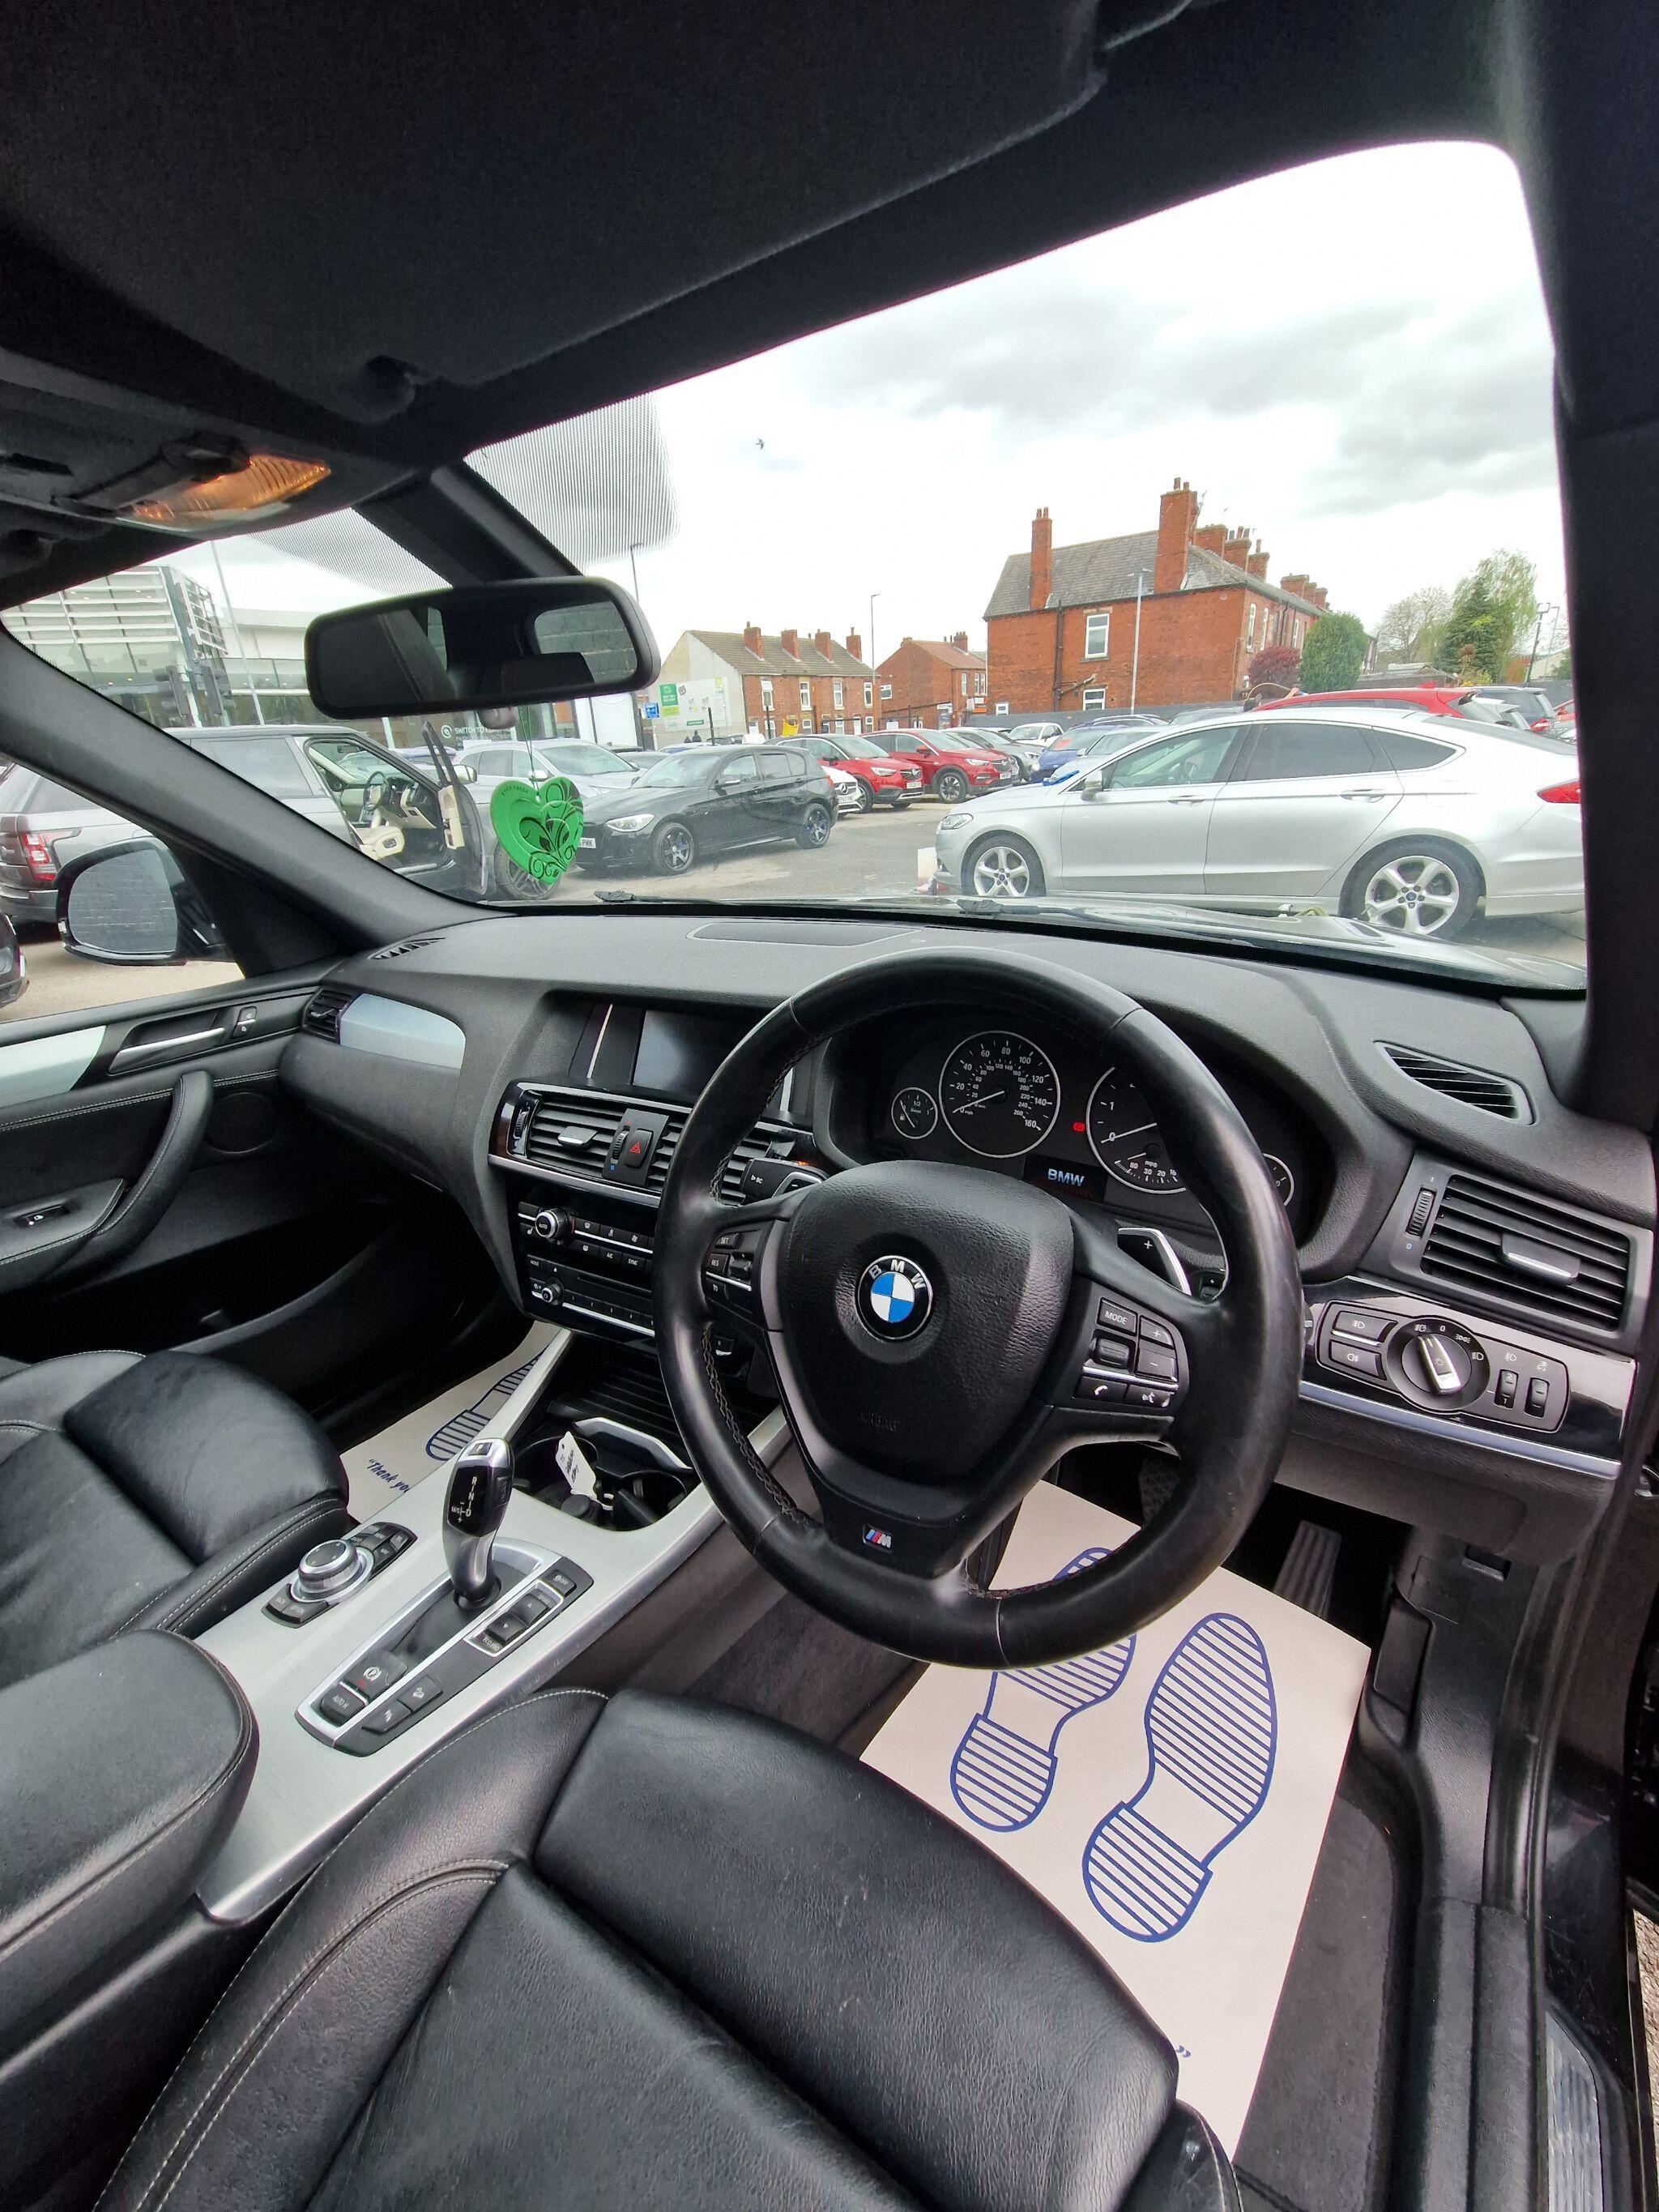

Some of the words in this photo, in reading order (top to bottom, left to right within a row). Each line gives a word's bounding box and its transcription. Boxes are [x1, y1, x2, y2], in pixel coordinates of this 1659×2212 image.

[1001, 1047, 1011, 1055] 80
[1019, 1056, 1031, 1065] 100
[1032, 1075, 1044, 1084] 120
[956, 1083, 965, 1091] 20
[1034, 1097, 1047, 1106] 140
[1110, 1101, 1115, 1111] 1
[1025, 1119, 1037, 1128] 160
[1108, 1132, 1116, 1142] 0
[1143, 1168, 1153, 1176] 30
[1157, 1169, 1166, 1177] 20
[1047, 1168, 1085, 1187] BMW
[868, 1258, 926, 1290] BMW
[1104, 1310, 1128, 1326] MODE
[471, 1476, 477, 1485] R
[466, 1509, 471, 1517] D
